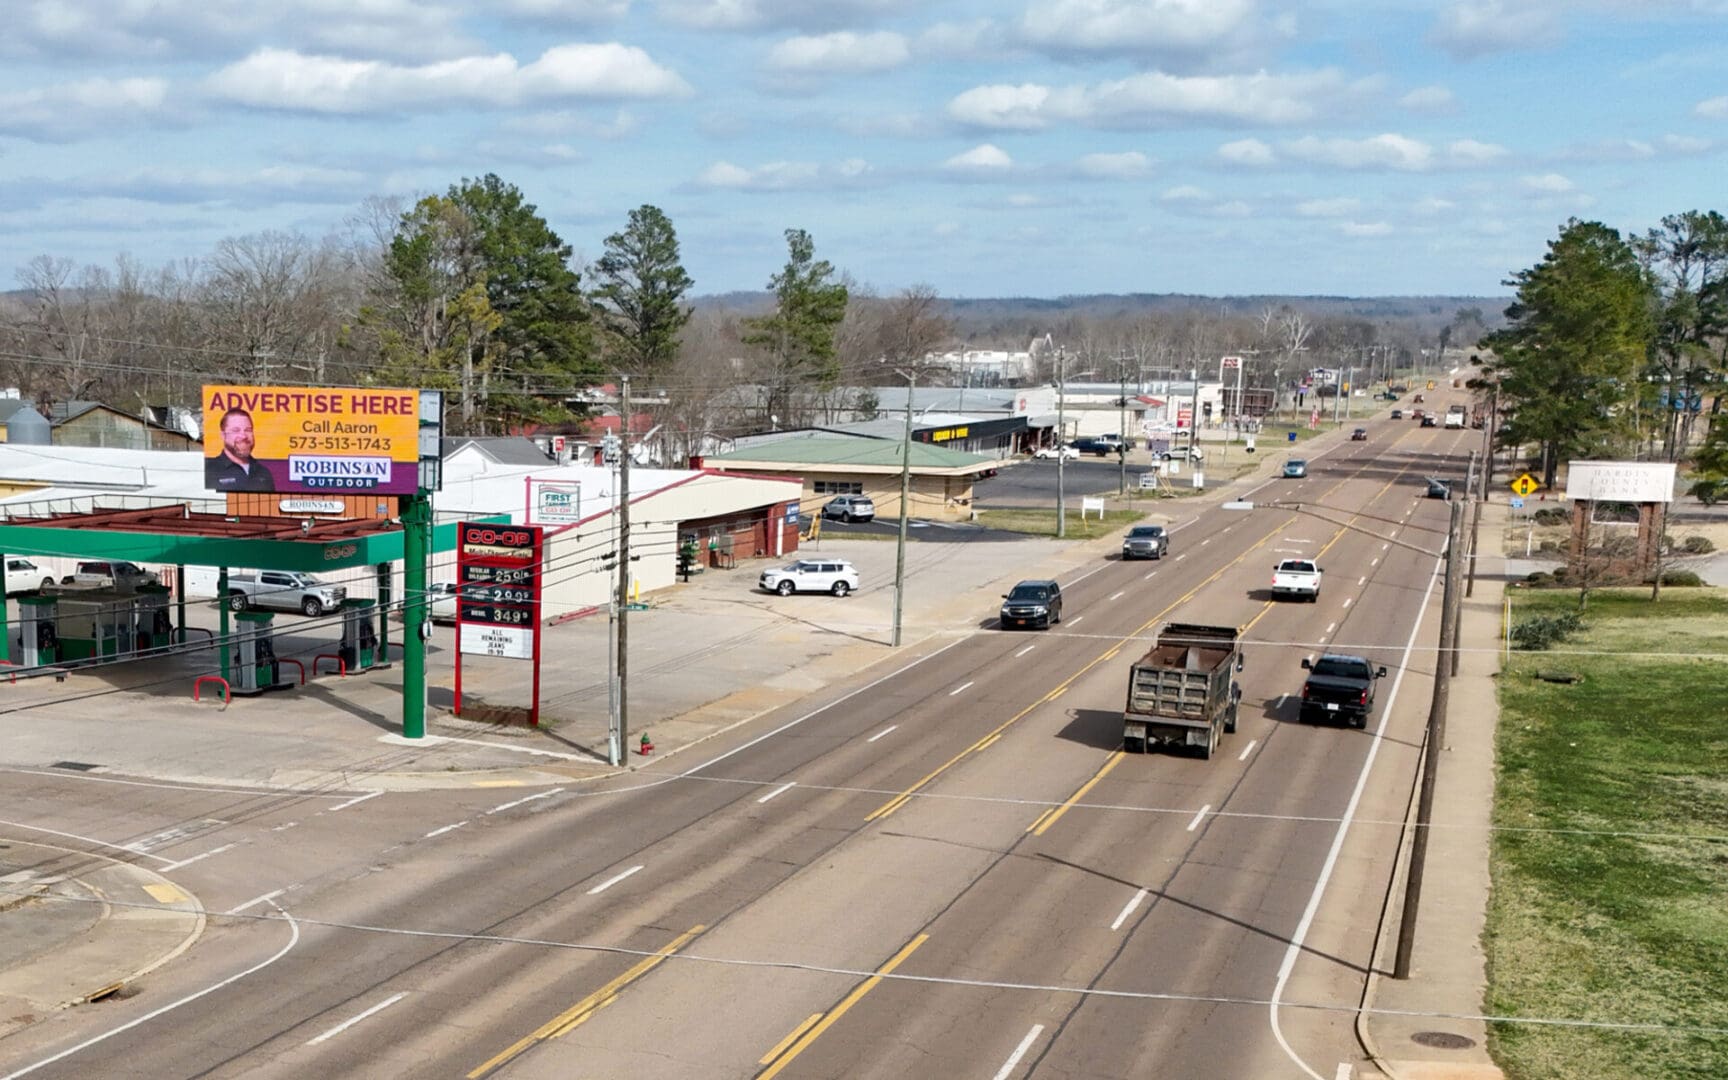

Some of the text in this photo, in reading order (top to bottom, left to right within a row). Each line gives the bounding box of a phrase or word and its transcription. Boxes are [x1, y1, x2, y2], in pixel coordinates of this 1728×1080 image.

[210, 392, 413, 415] ADVERTISE HERE
[302, 420, 377, 434] Call Aaron
[289, 436, 391, 451] 573-513-1743
[294, 460, 387, 475] ROBINSON
[1594, 469, 1650, 477] HARDIN
[308, 478, 373, 487] OUTDOOR
[545, 494, 571, 502] FIRST
[467, 529, 530, 546] CO-OP
[481, 635, 513, 643] REMAINING
